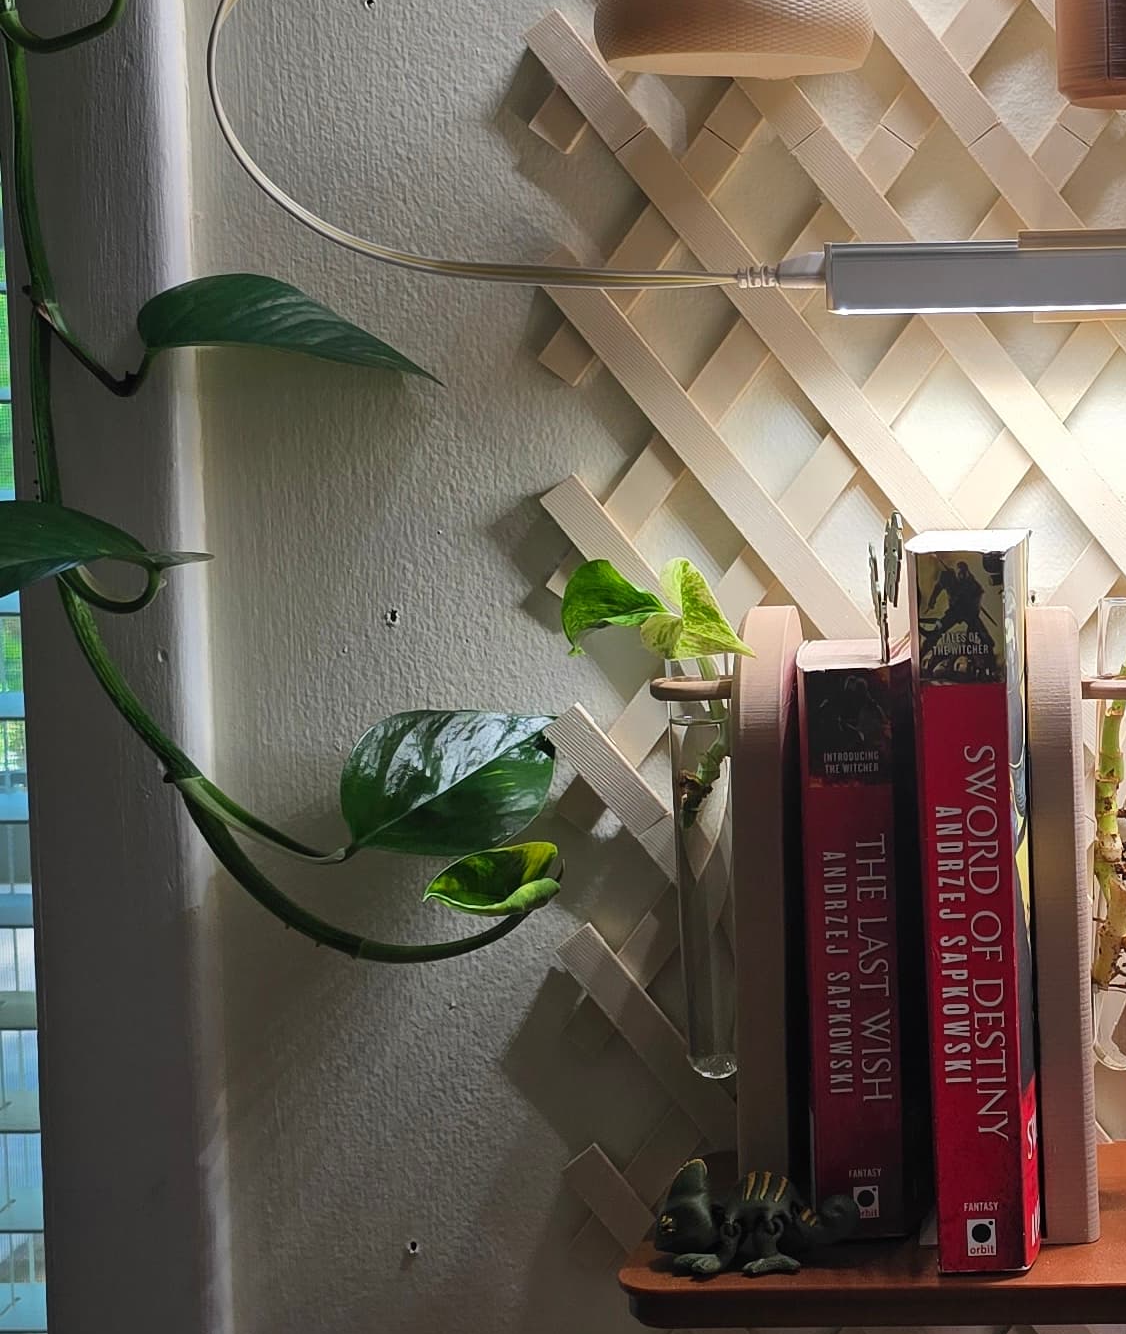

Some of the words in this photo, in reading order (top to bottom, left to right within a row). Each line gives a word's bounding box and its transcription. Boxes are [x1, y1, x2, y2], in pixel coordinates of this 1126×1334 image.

[933, 645, 949, 656] THE
[950, 643, 989, 655] WITCHER
[941, 632, 966, 644] TALES
[823, 750, 879, 763] INTRODUCING
[825, 763, 841, 774] THE
[842, 762, 879, 774] WITCHER
[963, 745, 1000, 895] SWORD
[855, 833, 887, 902] THE
[935, 806, 967, 920] ANDRZEJ
[822, 851, 849, 955] ANDRZEJ
[970, 910, 1003, 962] OF
[857, 916, 890, 997] LAST
[827, 970, 854, 1094] SAPKOWSKI
[939, 935, 972, 1084] SAPKOWSKI
[859, 1007, 893, 1102] WISH
[972, 978, 1009, 1142] DESTINY
[848, 1167, 881, 1179] FANTASY
[963, 1201, 999, 1212] FANTASY
[969, 1244, 995, 1255] orbit
